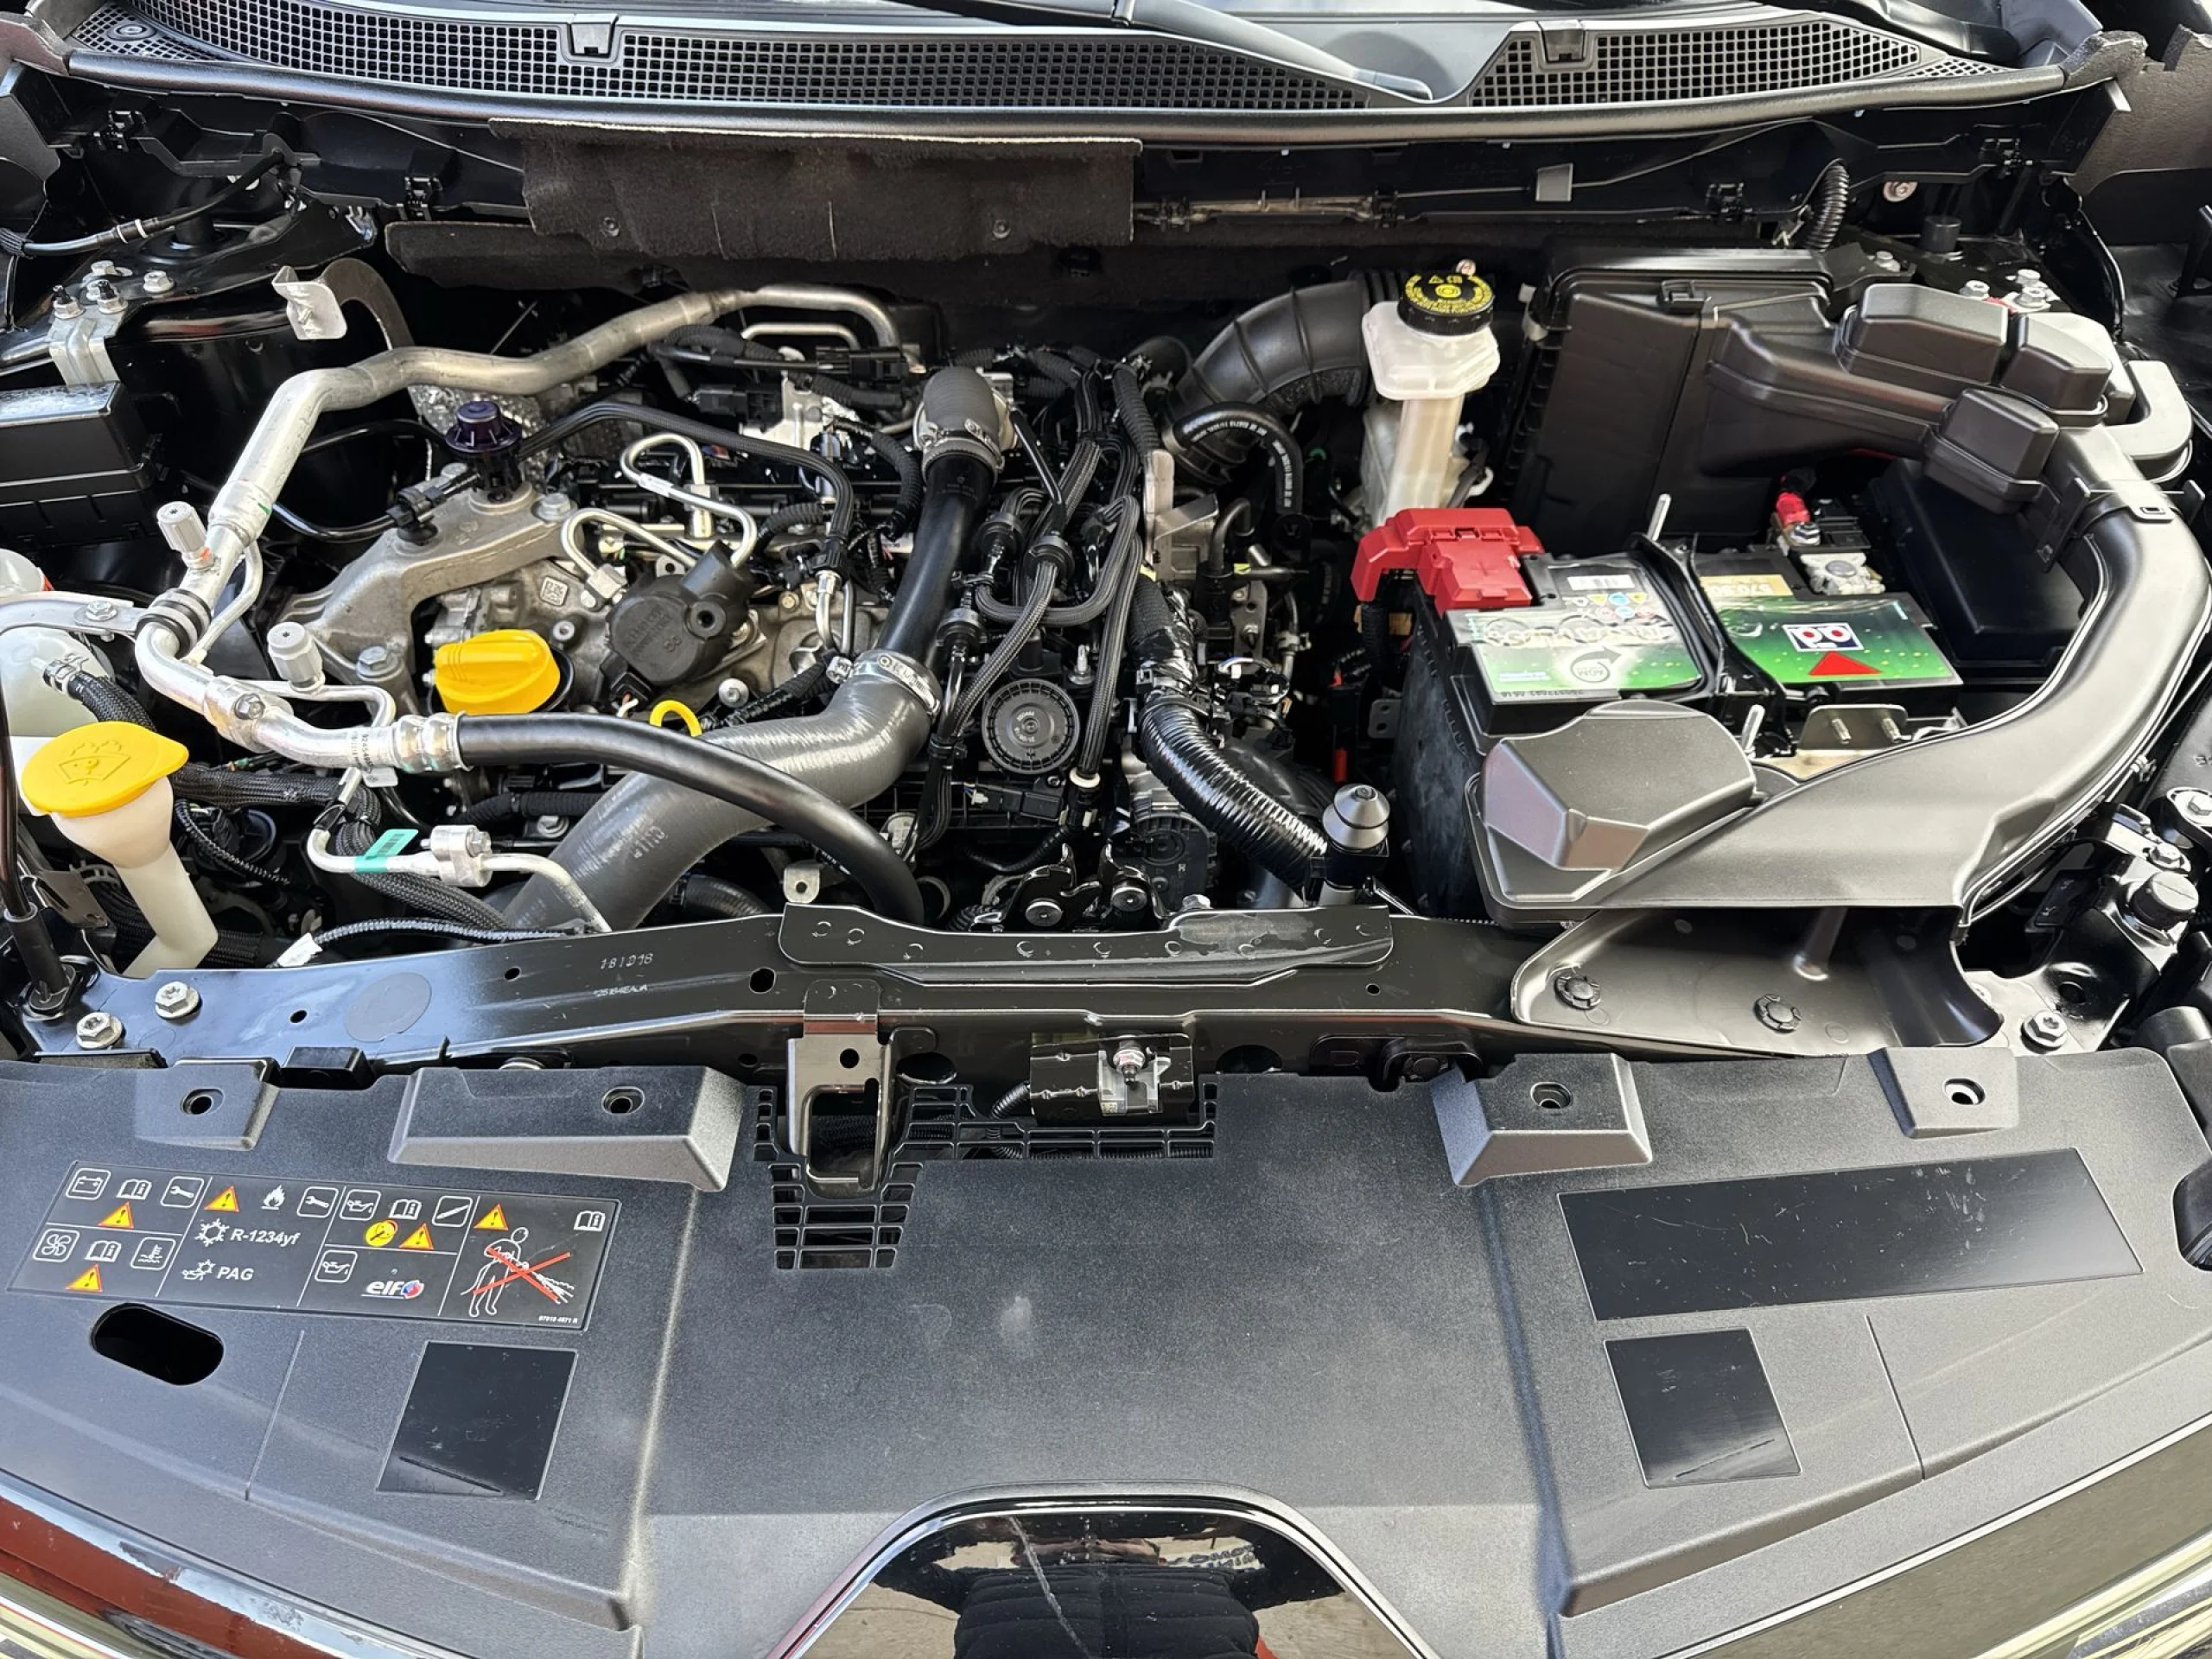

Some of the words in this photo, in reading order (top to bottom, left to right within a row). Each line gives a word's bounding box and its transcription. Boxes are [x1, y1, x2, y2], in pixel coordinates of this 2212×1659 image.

[230, 1228, 302, 1247] R-1234yf
[217, 1266, 254, 1281] PAG
[365, 1280, 407, 1297] elf
